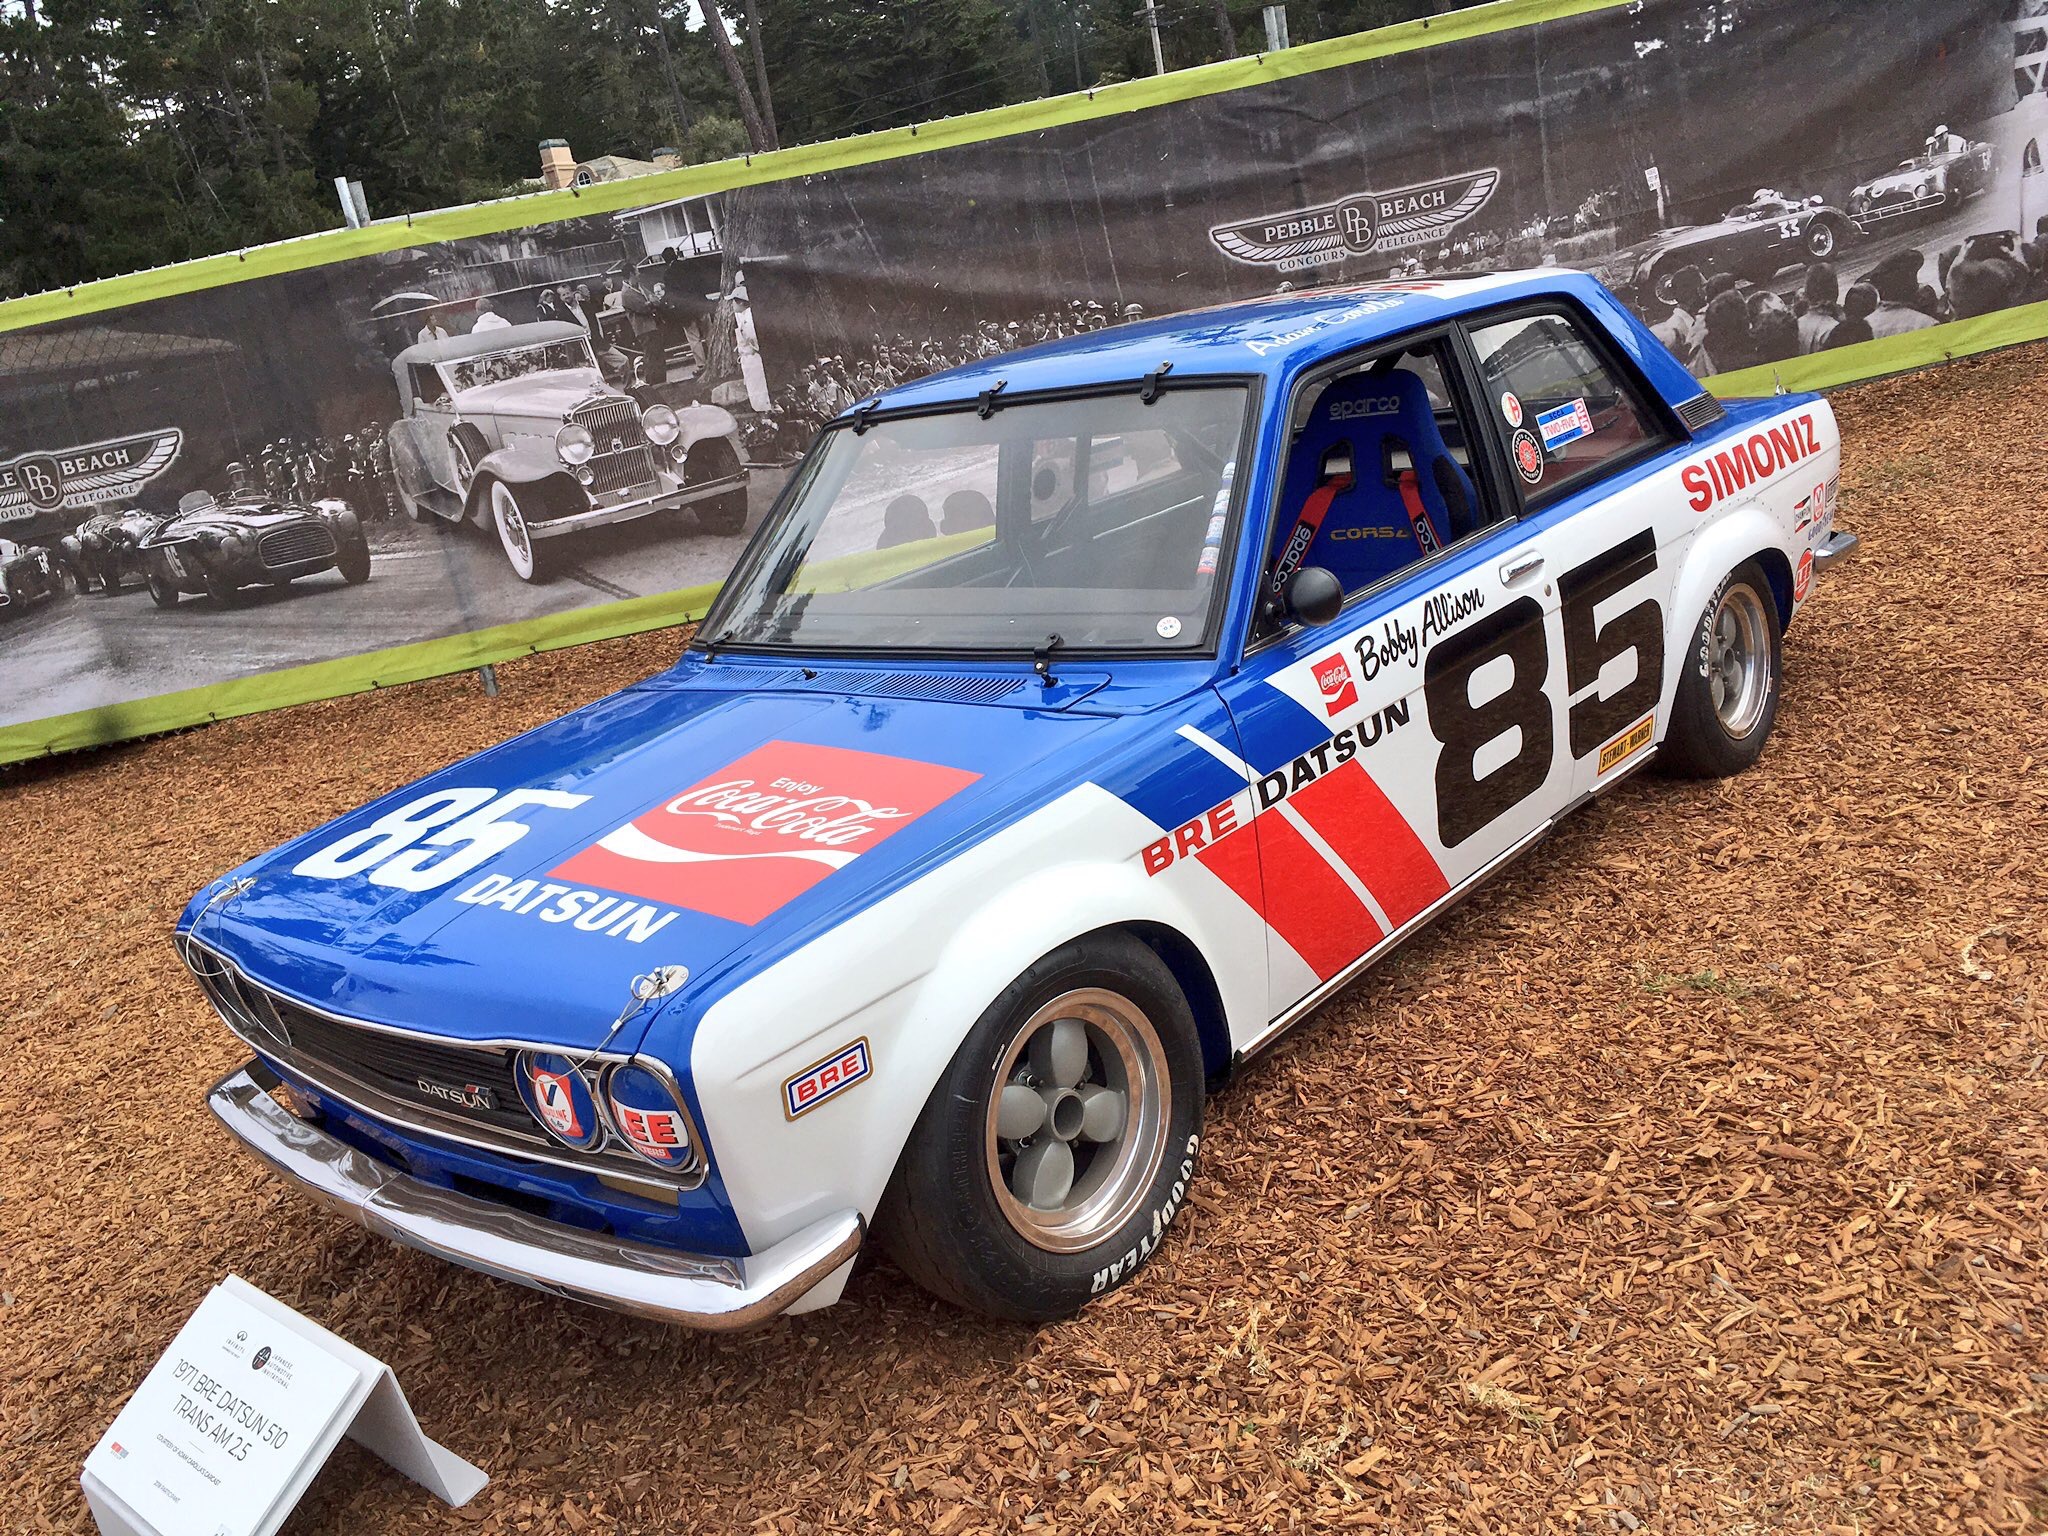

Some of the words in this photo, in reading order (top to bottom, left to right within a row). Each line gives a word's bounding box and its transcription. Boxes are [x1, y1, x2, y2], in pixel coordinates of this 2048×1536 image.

[1264, 214, 1336, 242] PEBBLE
[1380, 190, 1446, 218] BEACH
[1778, 218, 1800, 239] 33
[1279, 249, 1346, 271] CONCOURS
[1329, 396, 1400, 420] sparco
[1543, 416, 1576, 437] TWO-FIVE
[60, 449, 130, 476] BEACH
[1681, 414, 1821, 513] SIMONIZ
[1272, 526, 1311, 593] sparco
[1354, 618, 1419, 682] Bobby
[1422, 588, 1485, 648] Allison
[1424, 526, 1665, 849] 85
[665, 780, 912, 846] Coca-Cola
[769, 777, 824, 796] Enjoy
[1141, 799, 1239, 877] BRE
[1256, 697, 1410, 810] DATSUN
[292, 787, 595, 893] 85
[455, 873, 681, 943] DATSUN
[417, 1079, 491, 1110] DATSUN
[797, 1053, 860, 1102] BRE
[172, 1358, 199, 1386] 1971
[193, 1374, 222, 1402] BRE
[216, 1390, 269, 1436] DATSUN
[262, 1423, 288, 1449] 510
[173, 1393, 214, 1433] TRANS
[207, 1423, 235, 1449] AM
[228, 1437, 253, 1461] 2.5
